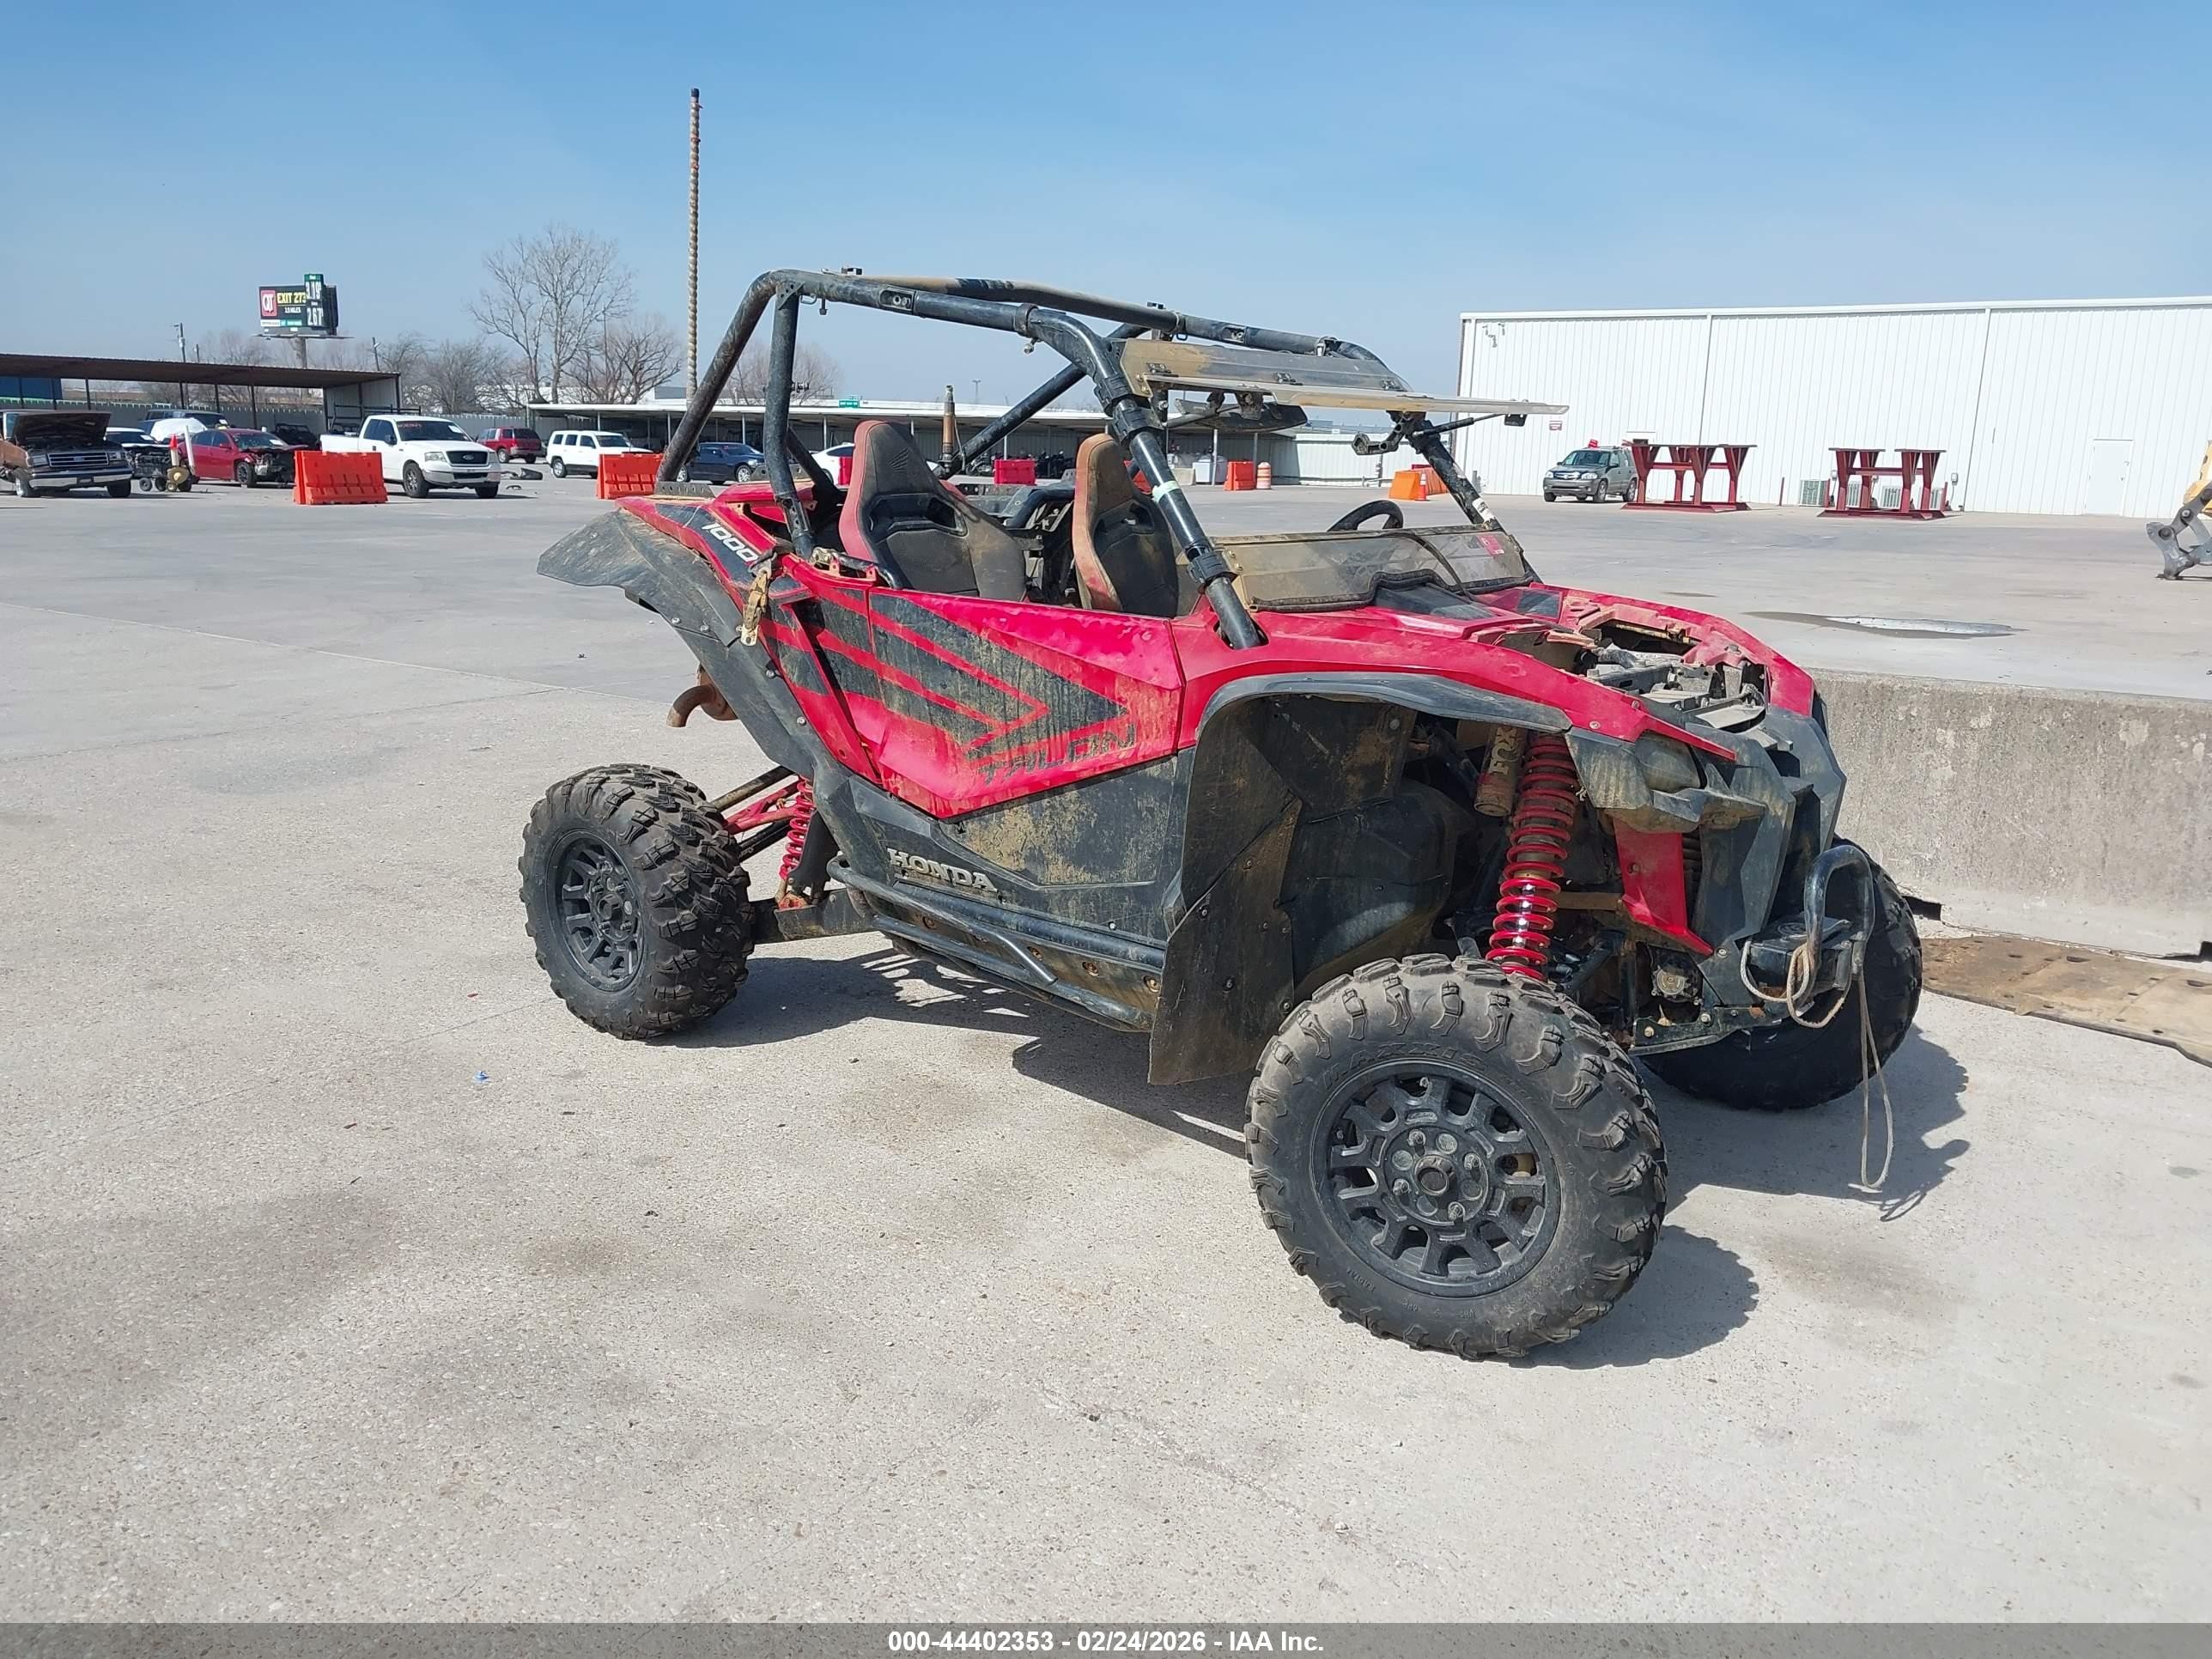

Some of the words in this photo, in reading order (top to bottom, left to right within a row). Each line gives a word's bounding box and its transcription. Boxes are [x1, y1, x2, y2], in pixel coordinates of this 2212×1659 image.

[262, 293, 275, 313] QT
[276, 292, 293, 304] EXIT
[701, 522, 759, 562] 1000
[976, 723, 1136, 785] TALON
[1488, 726, 1519, 775] FOX
[887, 848, 999, 893] HONDA
